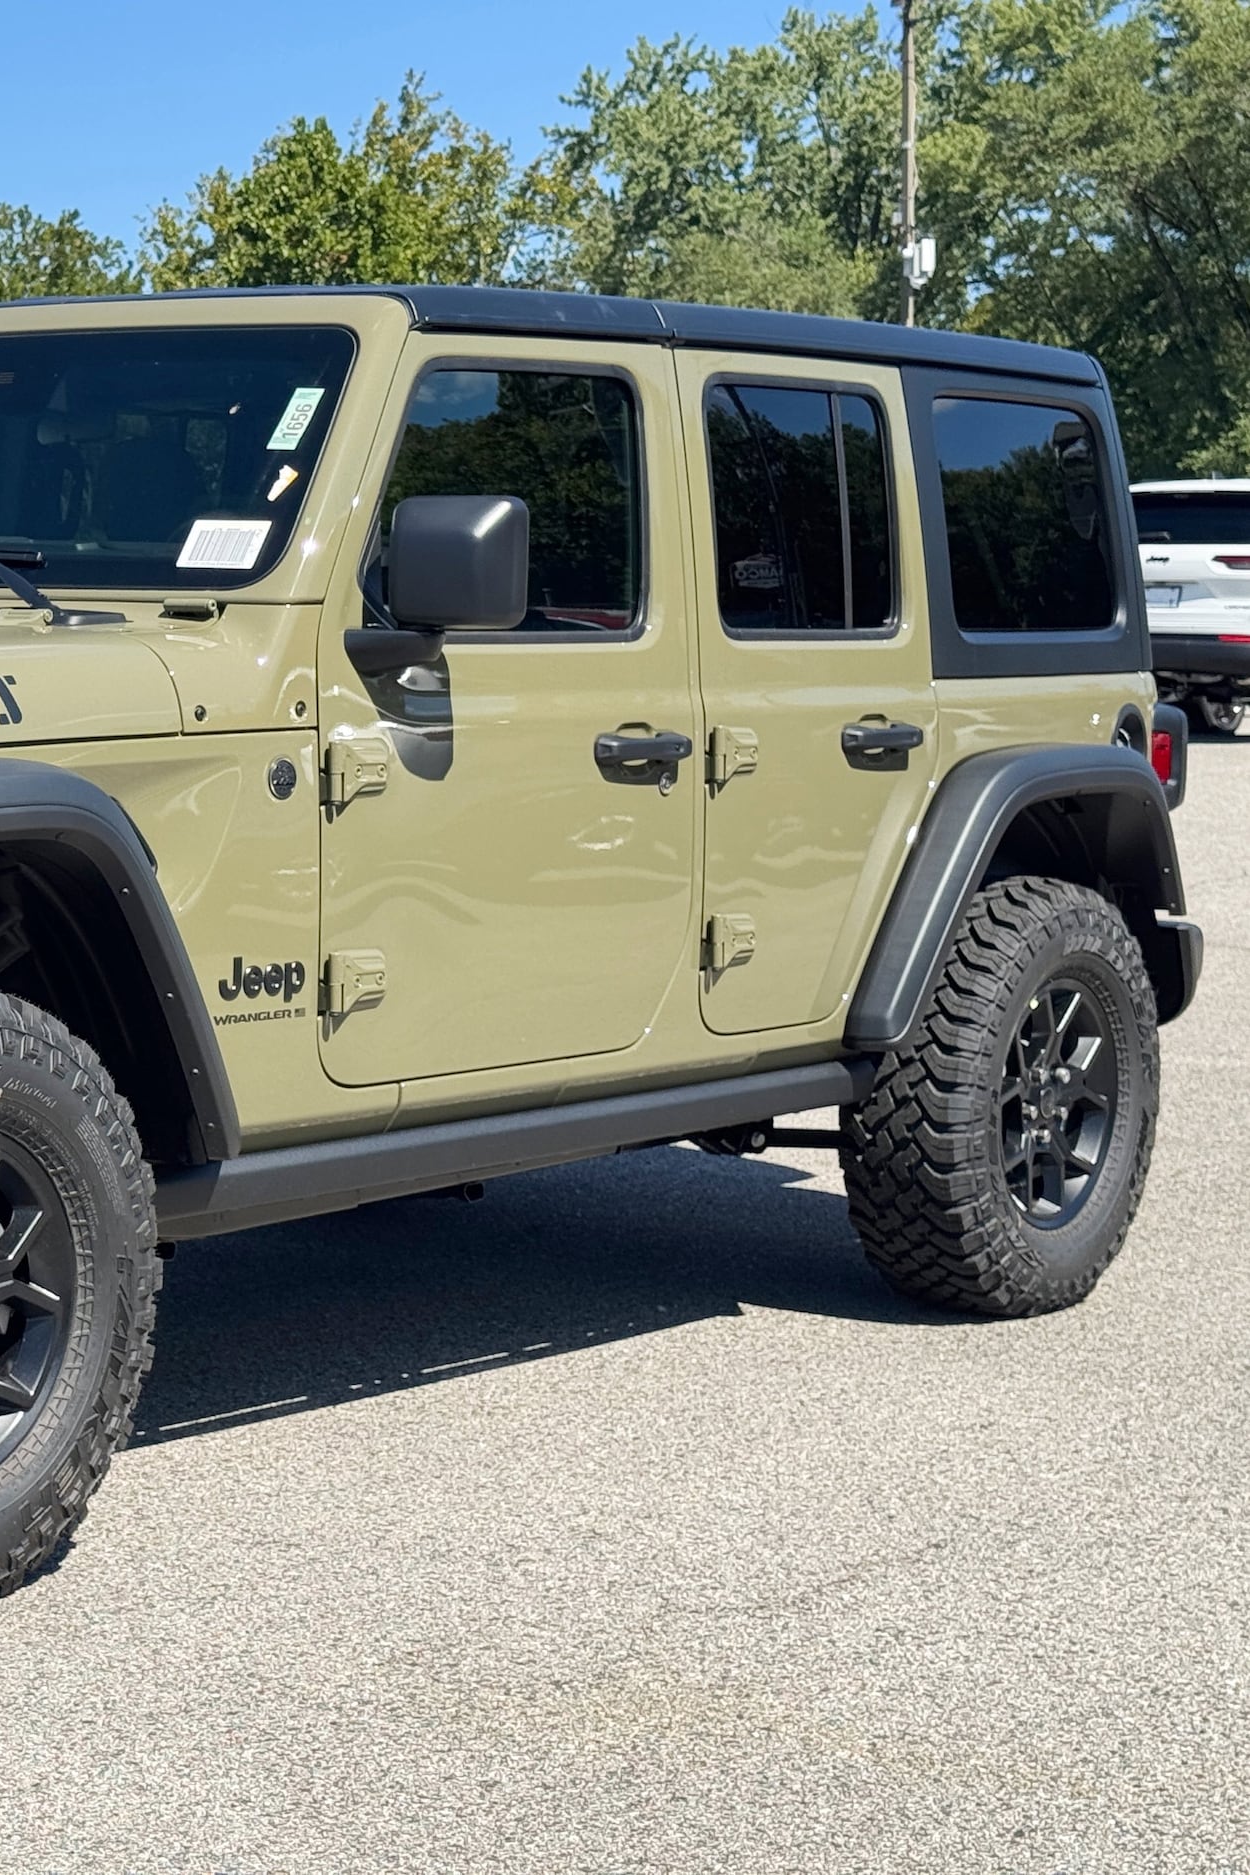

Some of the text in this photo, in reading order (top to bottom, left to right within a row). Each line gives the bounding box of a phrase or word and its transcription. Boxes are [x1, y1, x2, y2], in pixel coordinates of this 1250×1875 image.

[282, 403, 312, 439] 1656
[218, 956, 305, 1003] Jeep
[213, 1009, 292, 1026] WRANGLER
